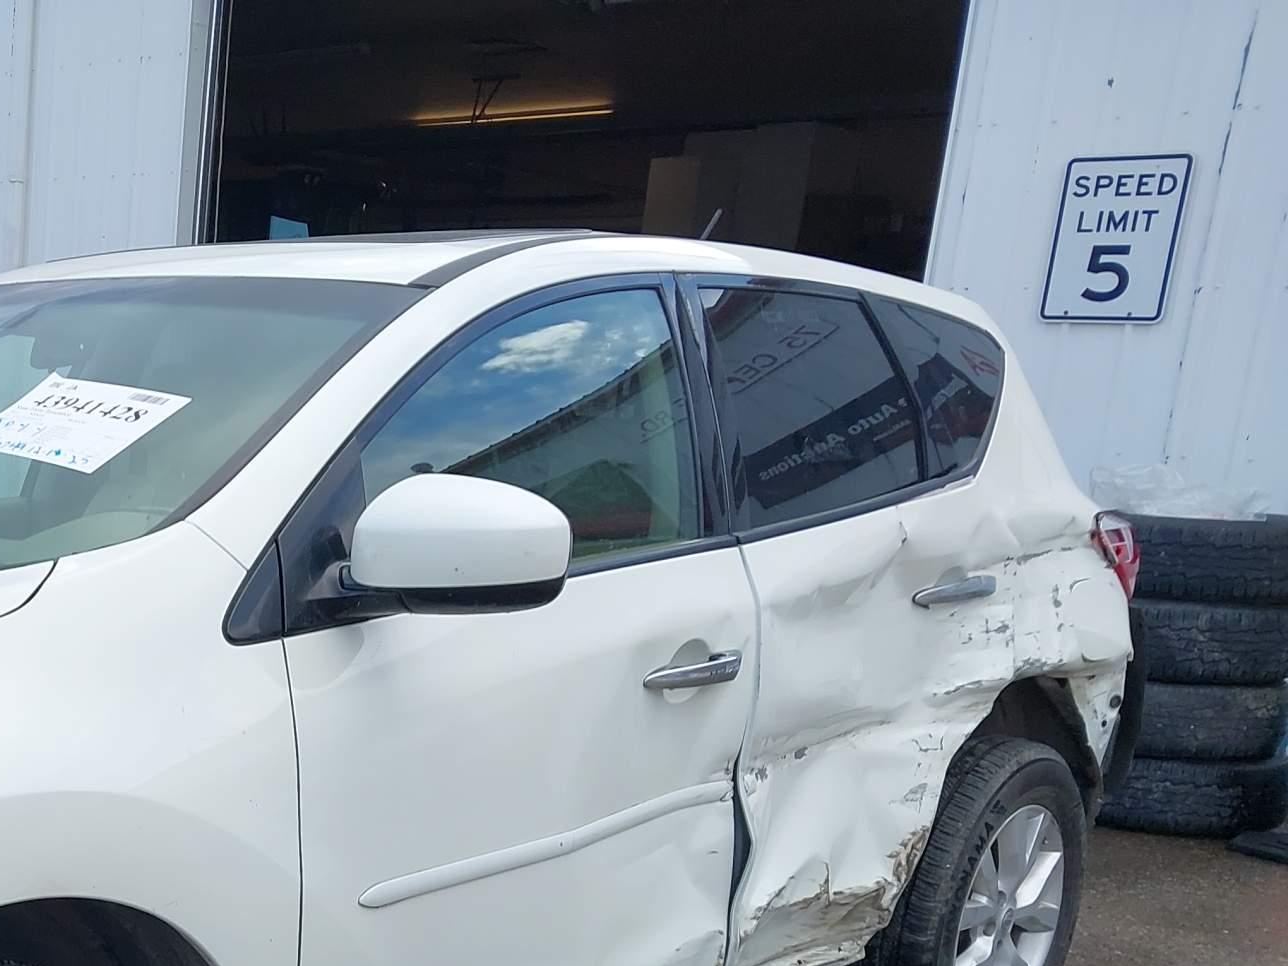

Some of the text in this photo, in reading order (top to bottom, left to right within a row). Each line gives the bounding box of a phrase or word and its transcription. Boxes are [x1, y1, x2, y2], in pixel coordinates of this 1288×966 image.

[1072, 173, 1178, 197] SPEED
[1076, 210, 1159, 232] LIMIT
[1080, 245, 1131, 302] 5
[34, 394, 148, 423] 43941428
